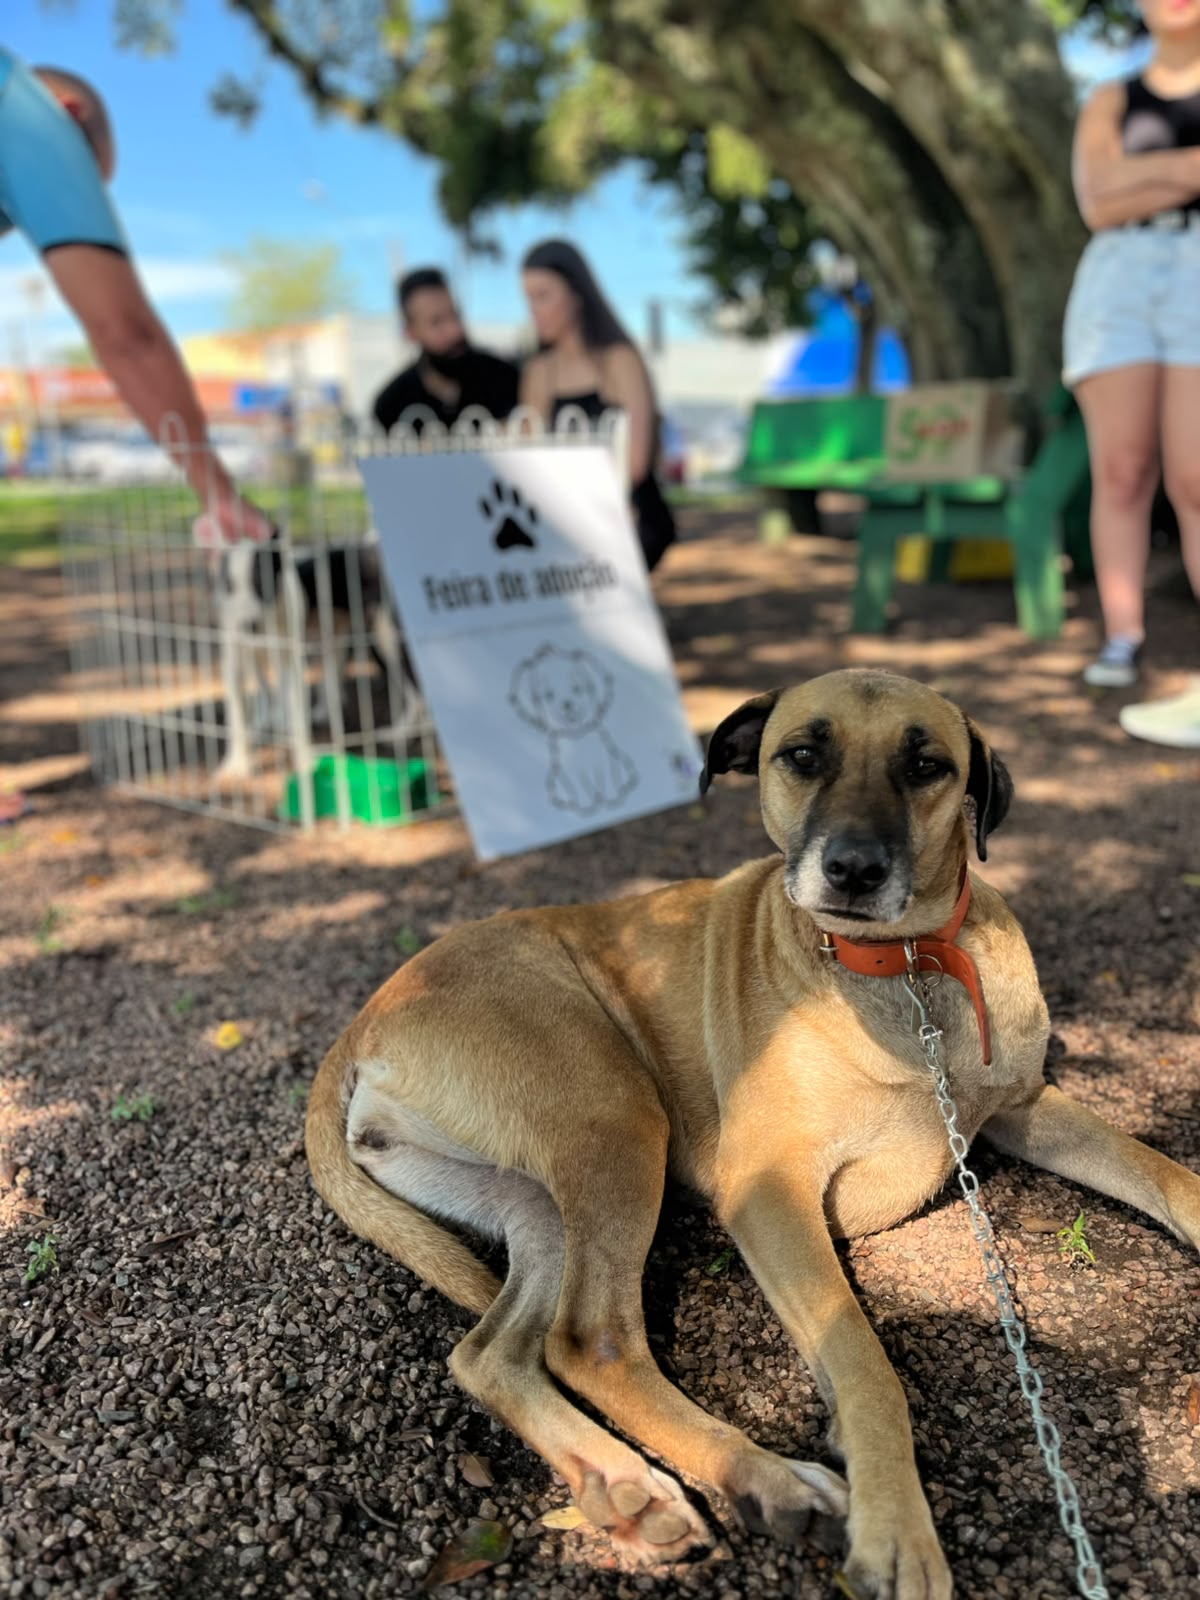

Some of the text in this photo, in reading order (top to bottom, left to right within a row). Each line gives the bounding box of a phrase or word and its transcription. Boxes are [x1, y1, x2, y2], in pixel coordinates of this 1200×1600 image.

[423, 558, 617, 612] Feira de adoção
